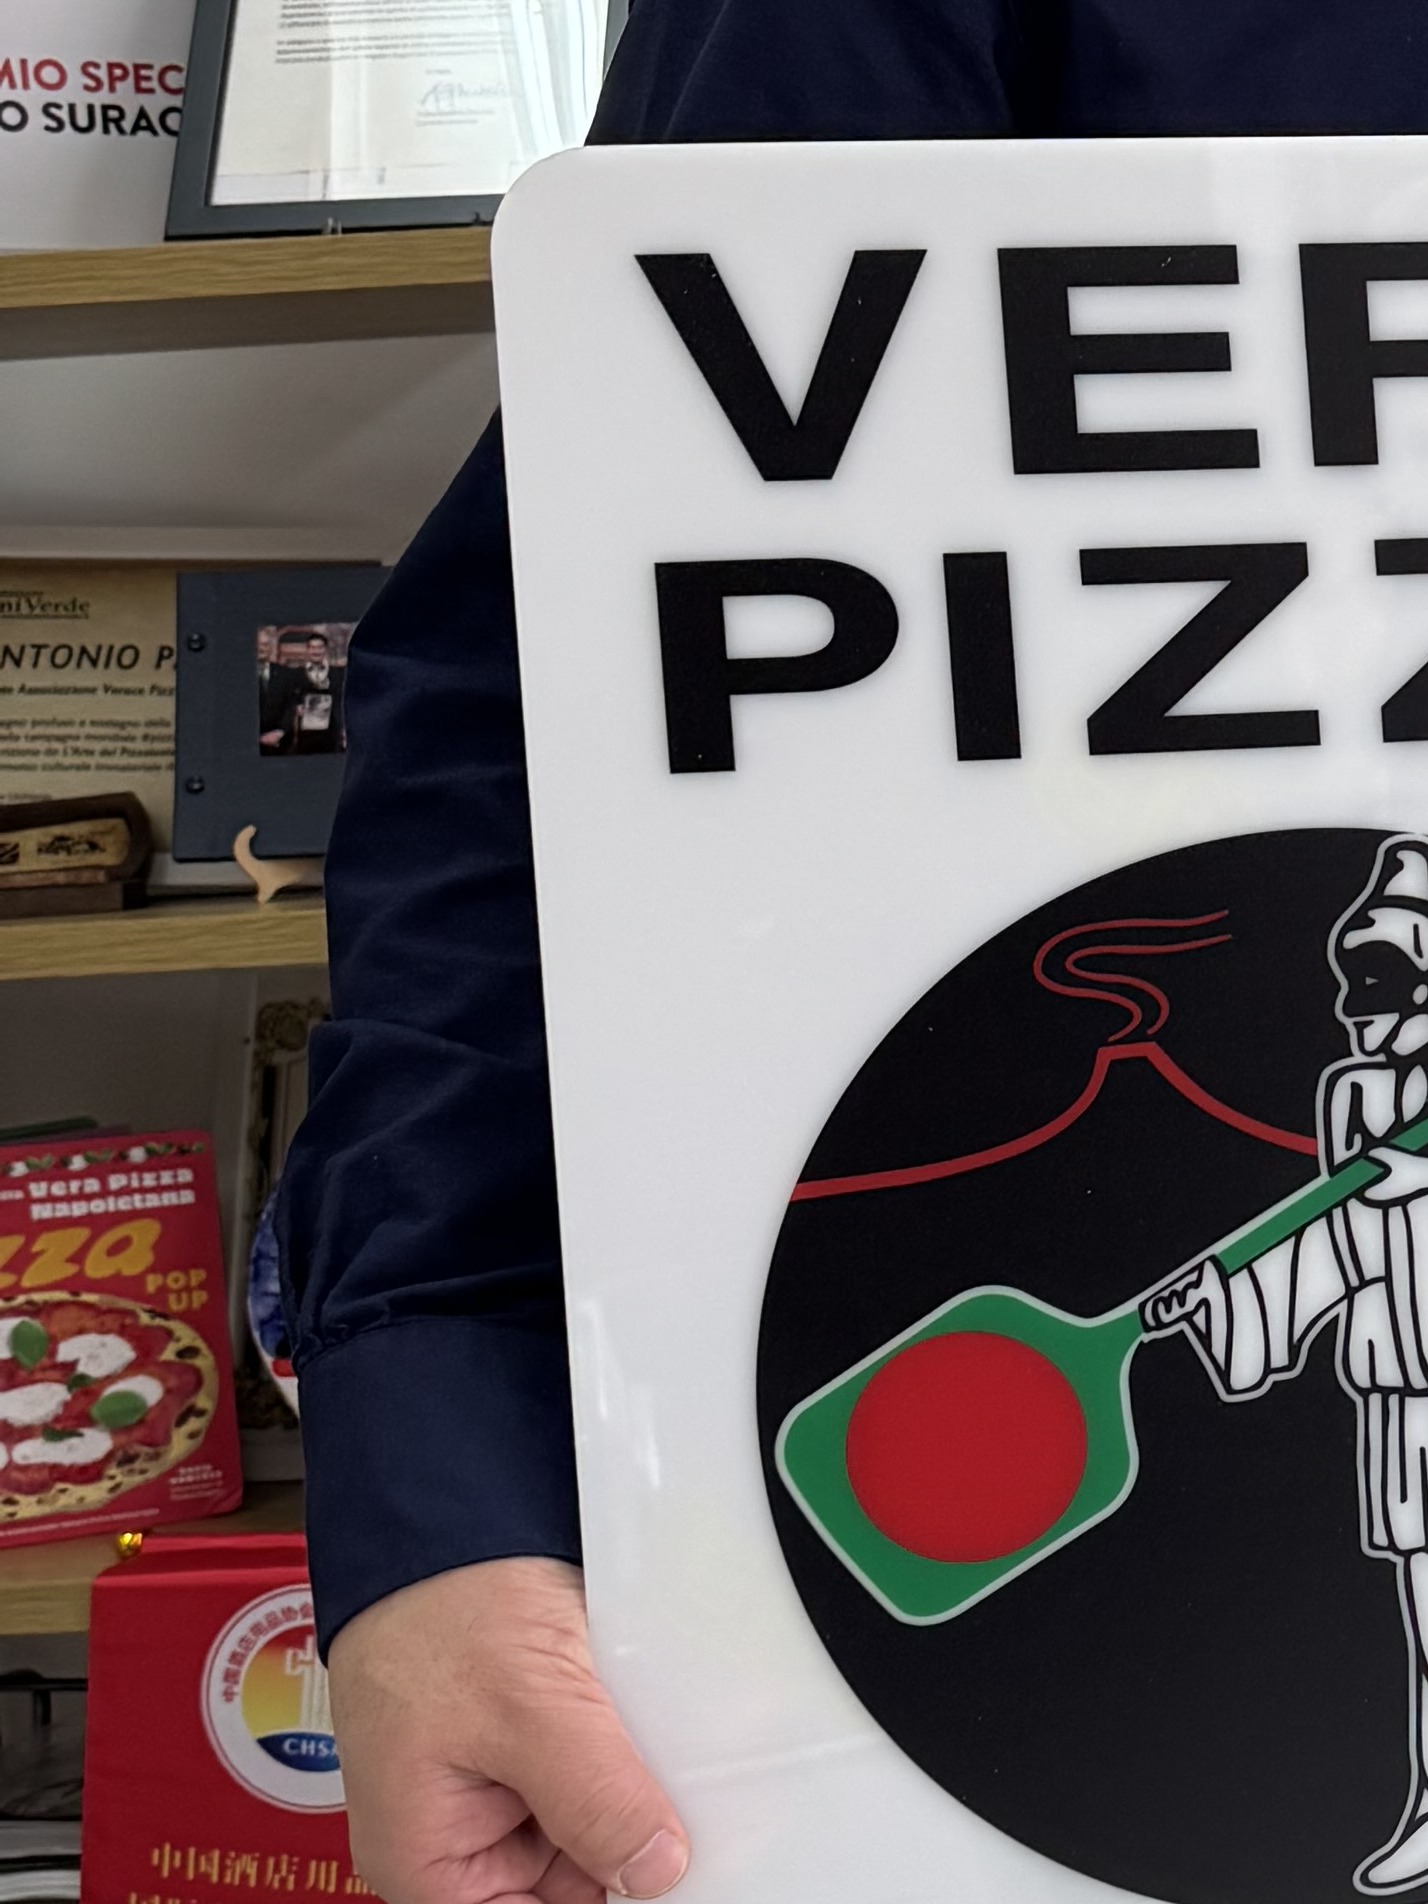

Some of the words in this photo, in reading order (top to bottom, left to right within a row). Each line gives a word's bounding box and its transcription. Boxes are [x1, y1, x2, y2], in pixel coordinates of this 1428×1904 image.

[107, 1167, 194, 1191] Pizza
[30, 1189, 196, 1221] Napoletana
[145, 1268, 207, 1294] POP
[167, 1289, 209, 1312] UP
